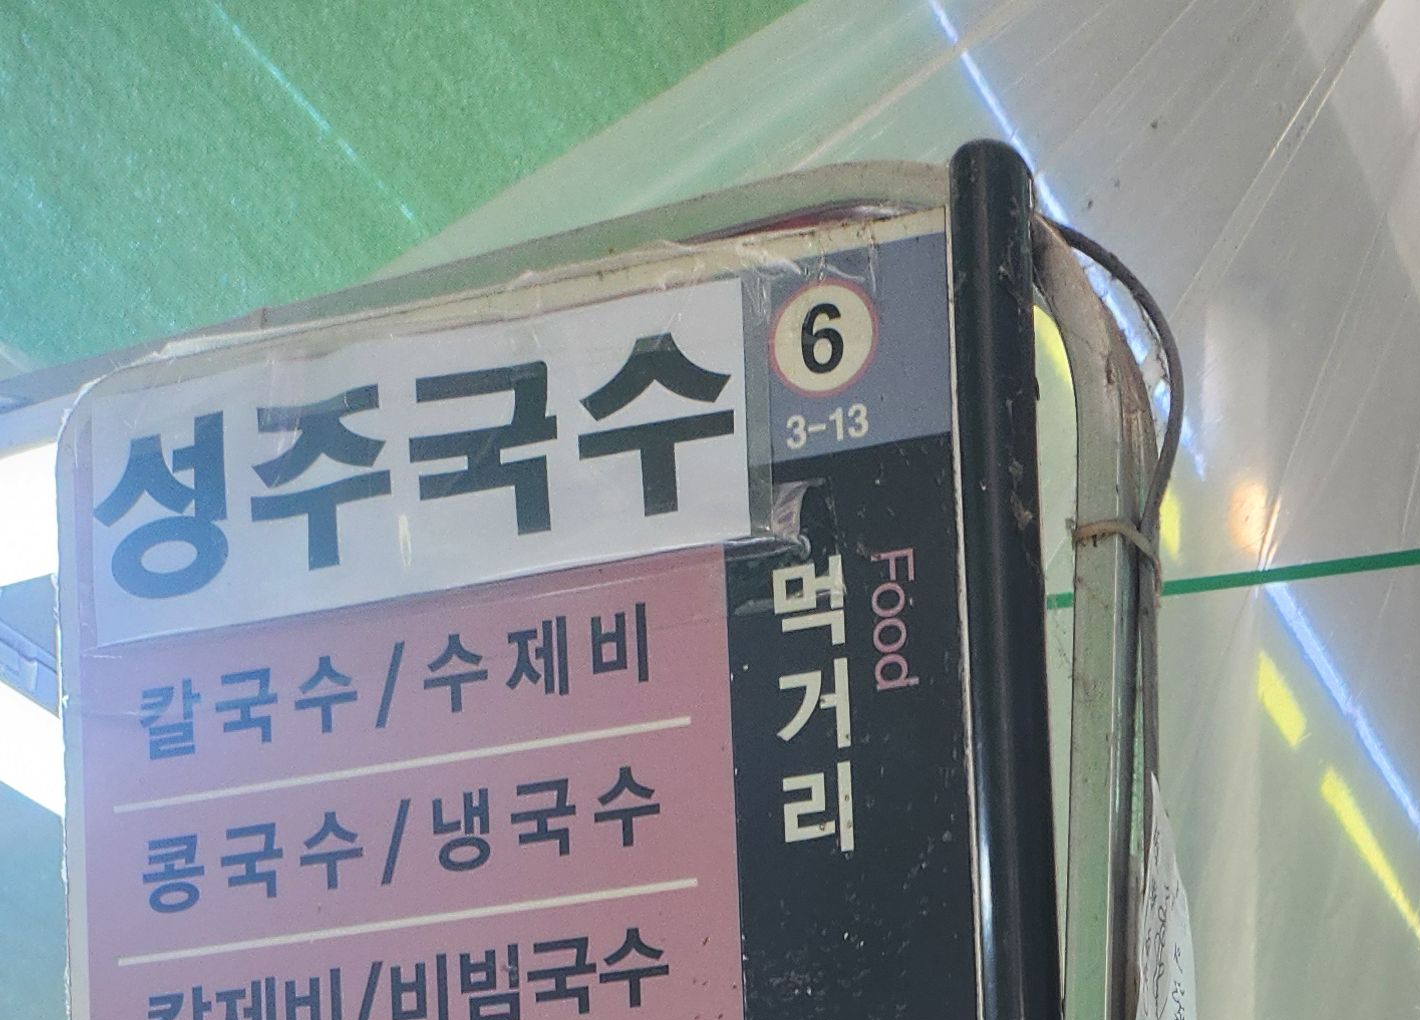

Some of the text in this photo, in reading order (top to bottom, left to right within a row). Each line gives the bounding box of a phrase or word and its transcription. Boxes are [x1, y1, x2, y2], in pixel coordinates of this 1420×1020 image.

[799, 301, 846, 375] 6
[94, 331, 735, 600] 성주국수
[786, 404, 870, 451] 3-13
[140, 600, 651, 761] 칼국수/수제비
[872, 547, 918, 689] Food
[770, 556, 855, 853] 먹거리
[141, 766, 662, 914] 콩국수/냉국수
